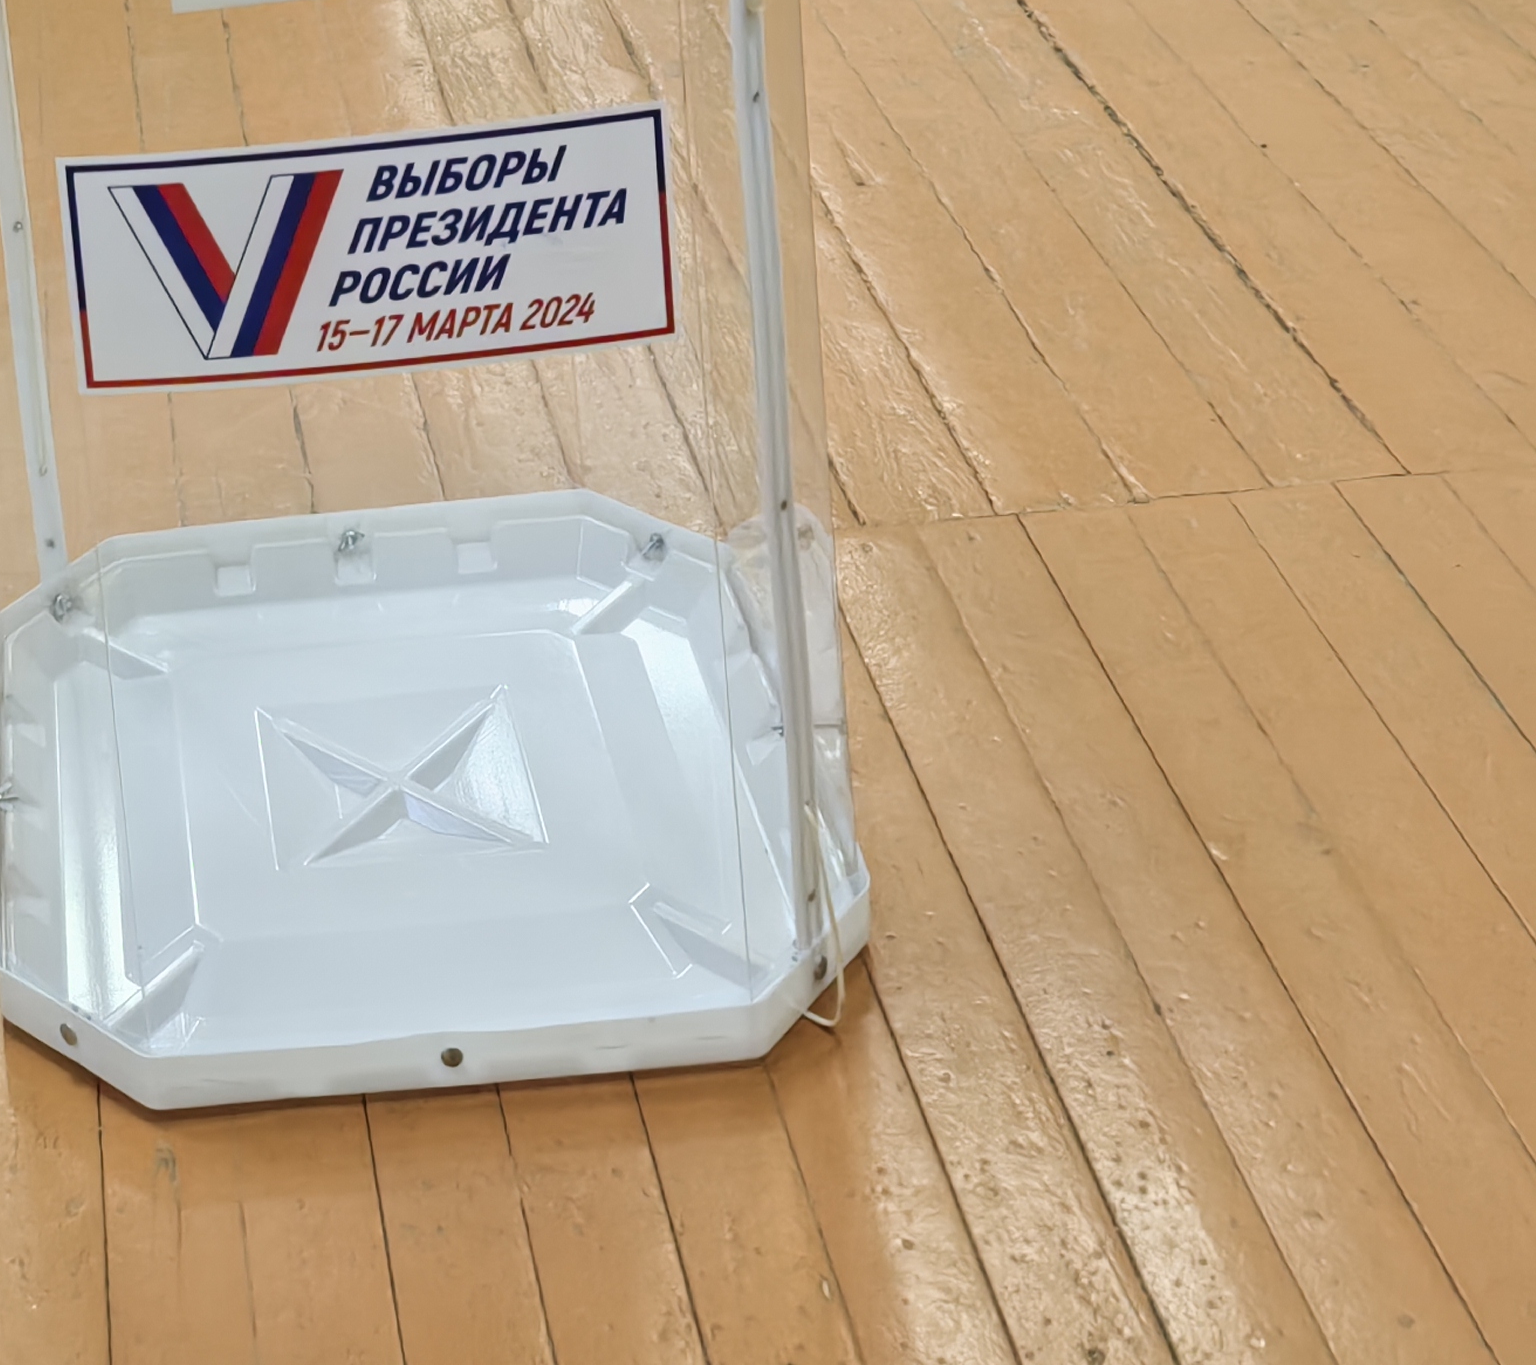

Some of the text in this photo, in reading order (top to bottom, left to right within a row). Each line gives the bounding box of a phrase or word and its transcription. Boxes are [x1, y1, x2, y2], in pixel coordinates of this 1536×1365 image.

[366, 144, 567, 203] ВЫБОРЫ
[347, 187, 628, 255] ПРЕЗИДЕНТА
[328, 253, 511, 307] РОССИИ
[406, 302, 514, 344] МАРТА
[519, 292, 596, 331] 2024
